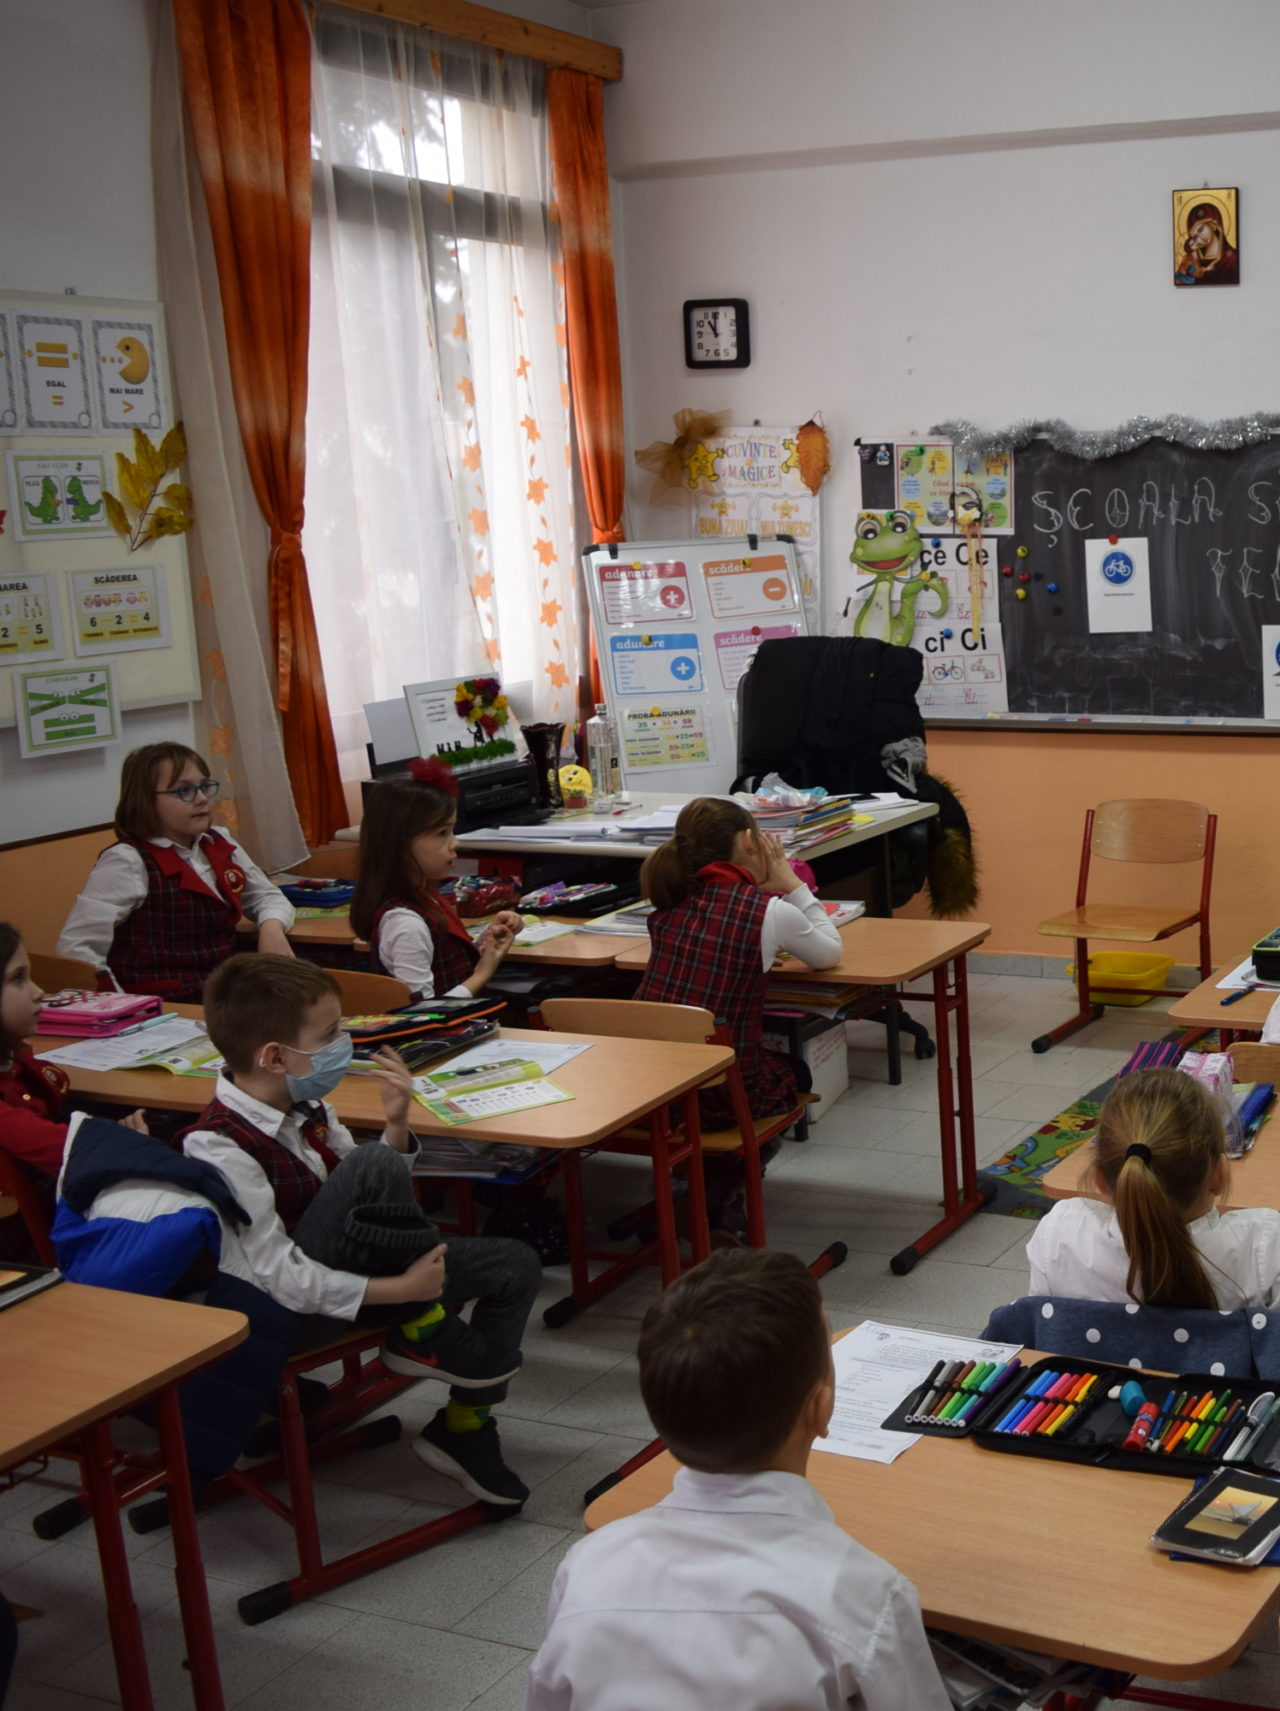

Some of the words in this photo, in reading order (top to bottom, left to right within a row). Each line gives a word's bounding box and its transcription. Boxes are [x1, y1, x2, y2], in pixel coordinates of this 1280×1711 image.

[46, 380, 67, 388] EGAL
[109, 387, 123, 395] MAI
[124, 387, 145, 396] MARE
[726, 440, 776, 458] CUVINTE
[728, 465, 776, 481] MAGICE
[919, 549, 947, 566] ce
[709, 562, 752, 575] scădere
[94, 574, 138, 584] SCĂDEREA
[90, 617, 97, 627] 6
[115, 615, 123, 625] 2
[143, 612, 150, 622] 4
[1, 627, 9, 637] 2
[35, 624, 43, 634] 5
[925, 631, 945, 653] ci
[961, 628, 987, 652] Ci
